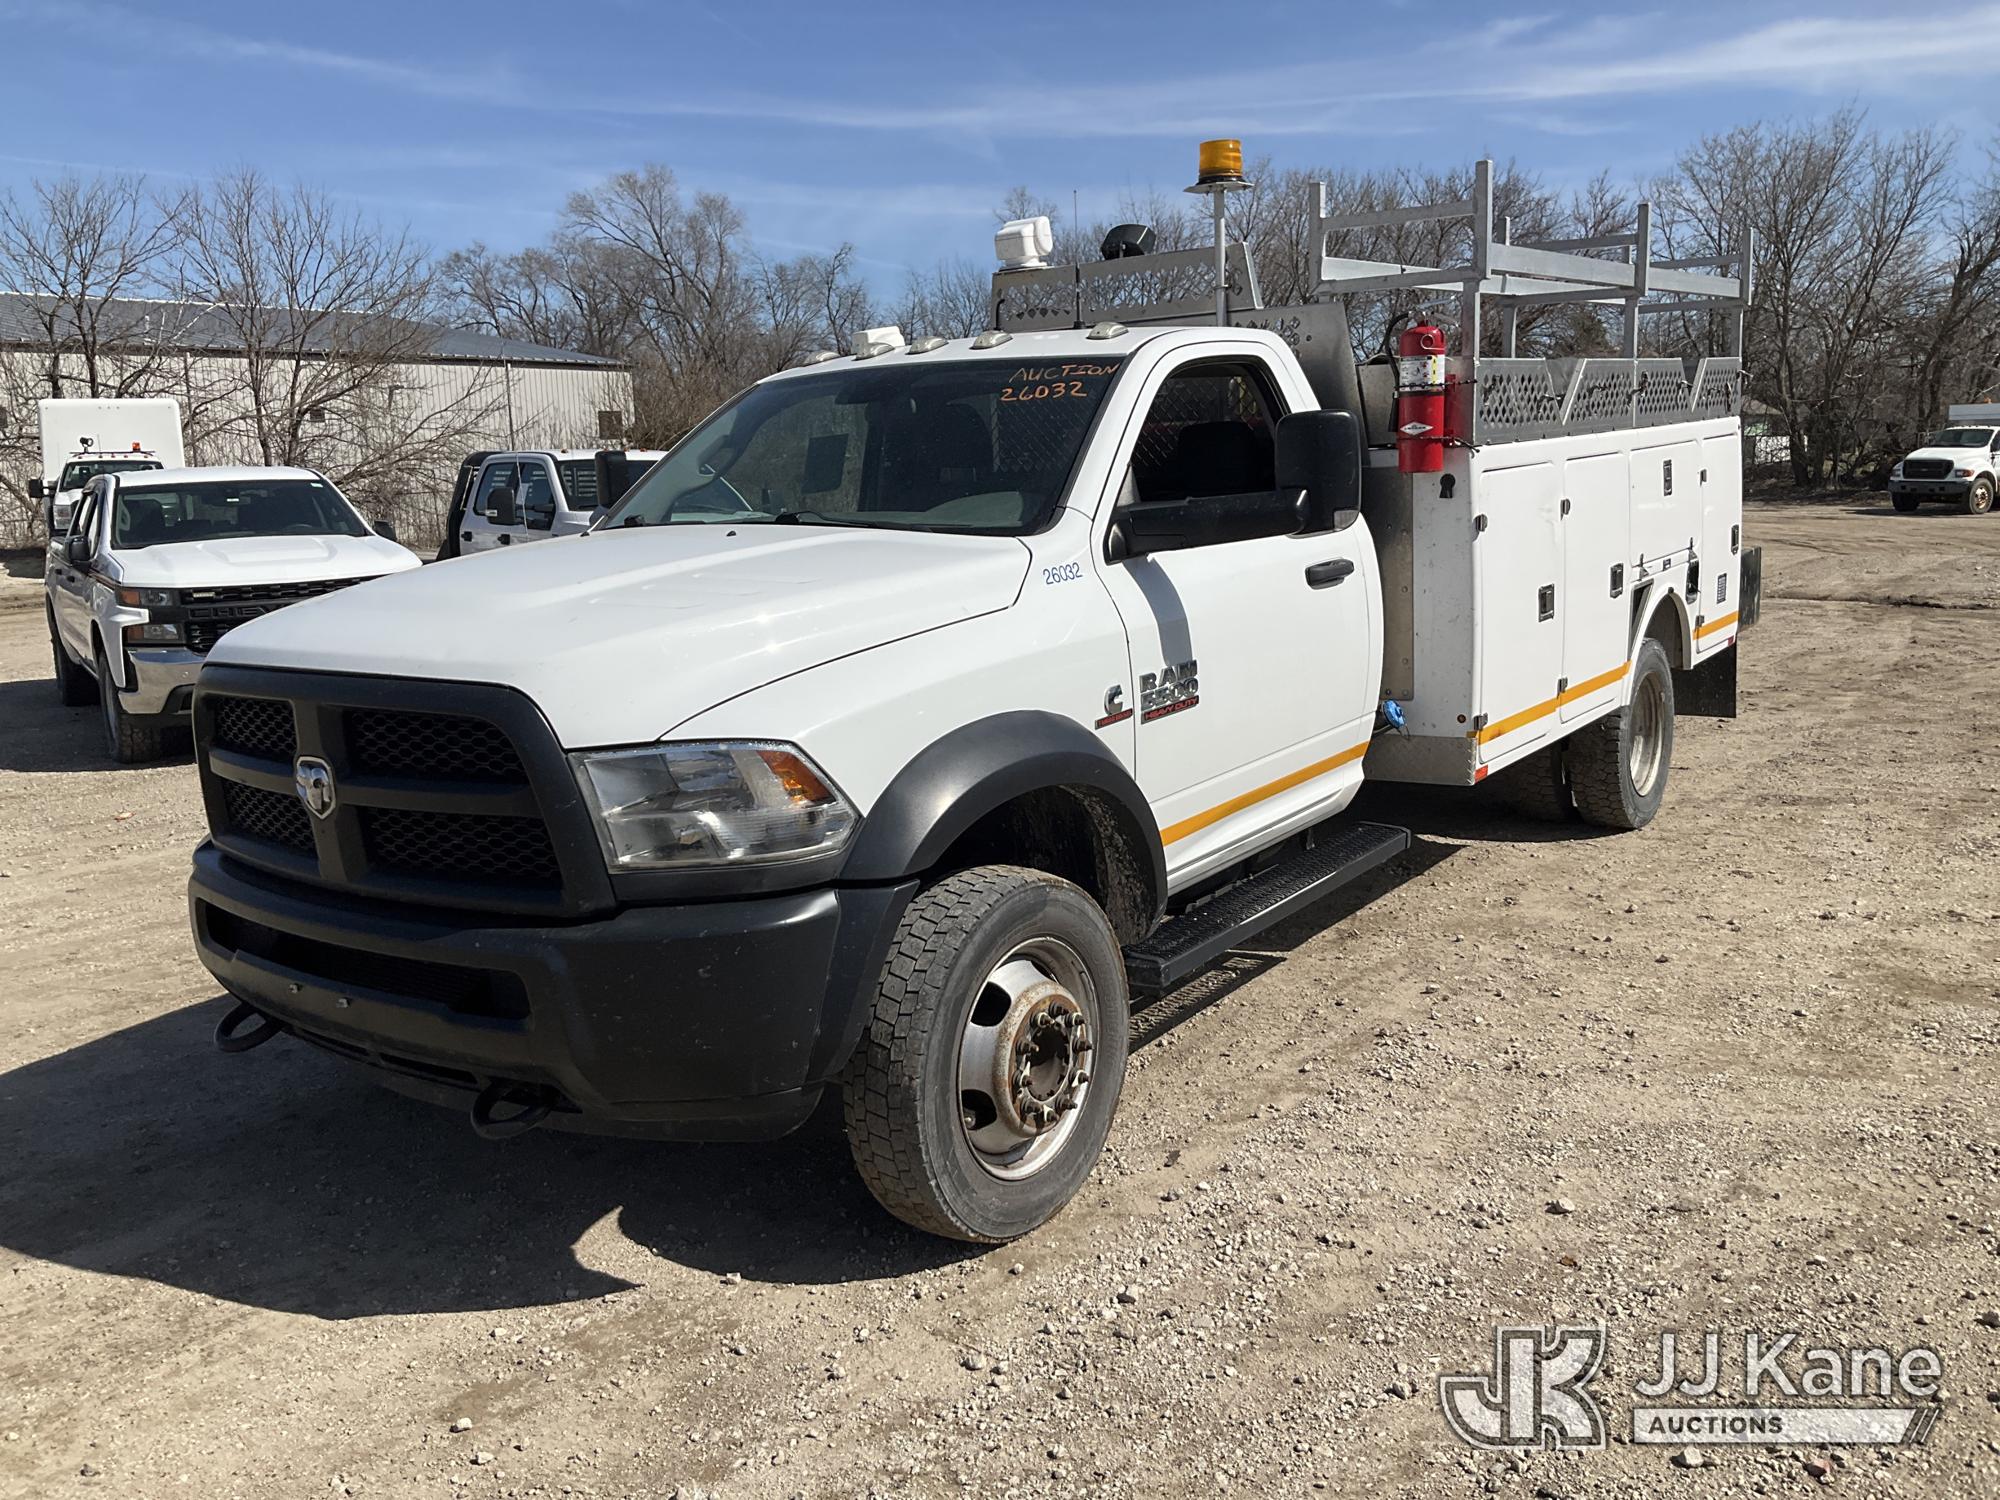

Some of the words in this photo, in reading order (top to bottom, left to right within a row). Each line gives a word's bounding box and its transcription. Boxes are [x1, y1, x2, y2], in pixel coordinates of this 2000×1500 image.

[1008, 363, 1120, 383] AUCTION
[1001, 381, 1087, 401] 26032
[1042, 562, 1083, 585] 26032
[1139, 659, 1198, 693] RAM
[1140, 677, 1199, 711] 5500
[1144, 703, 1174, 720] HEAVY
[1175, 698, 1197, 709] DUTY
